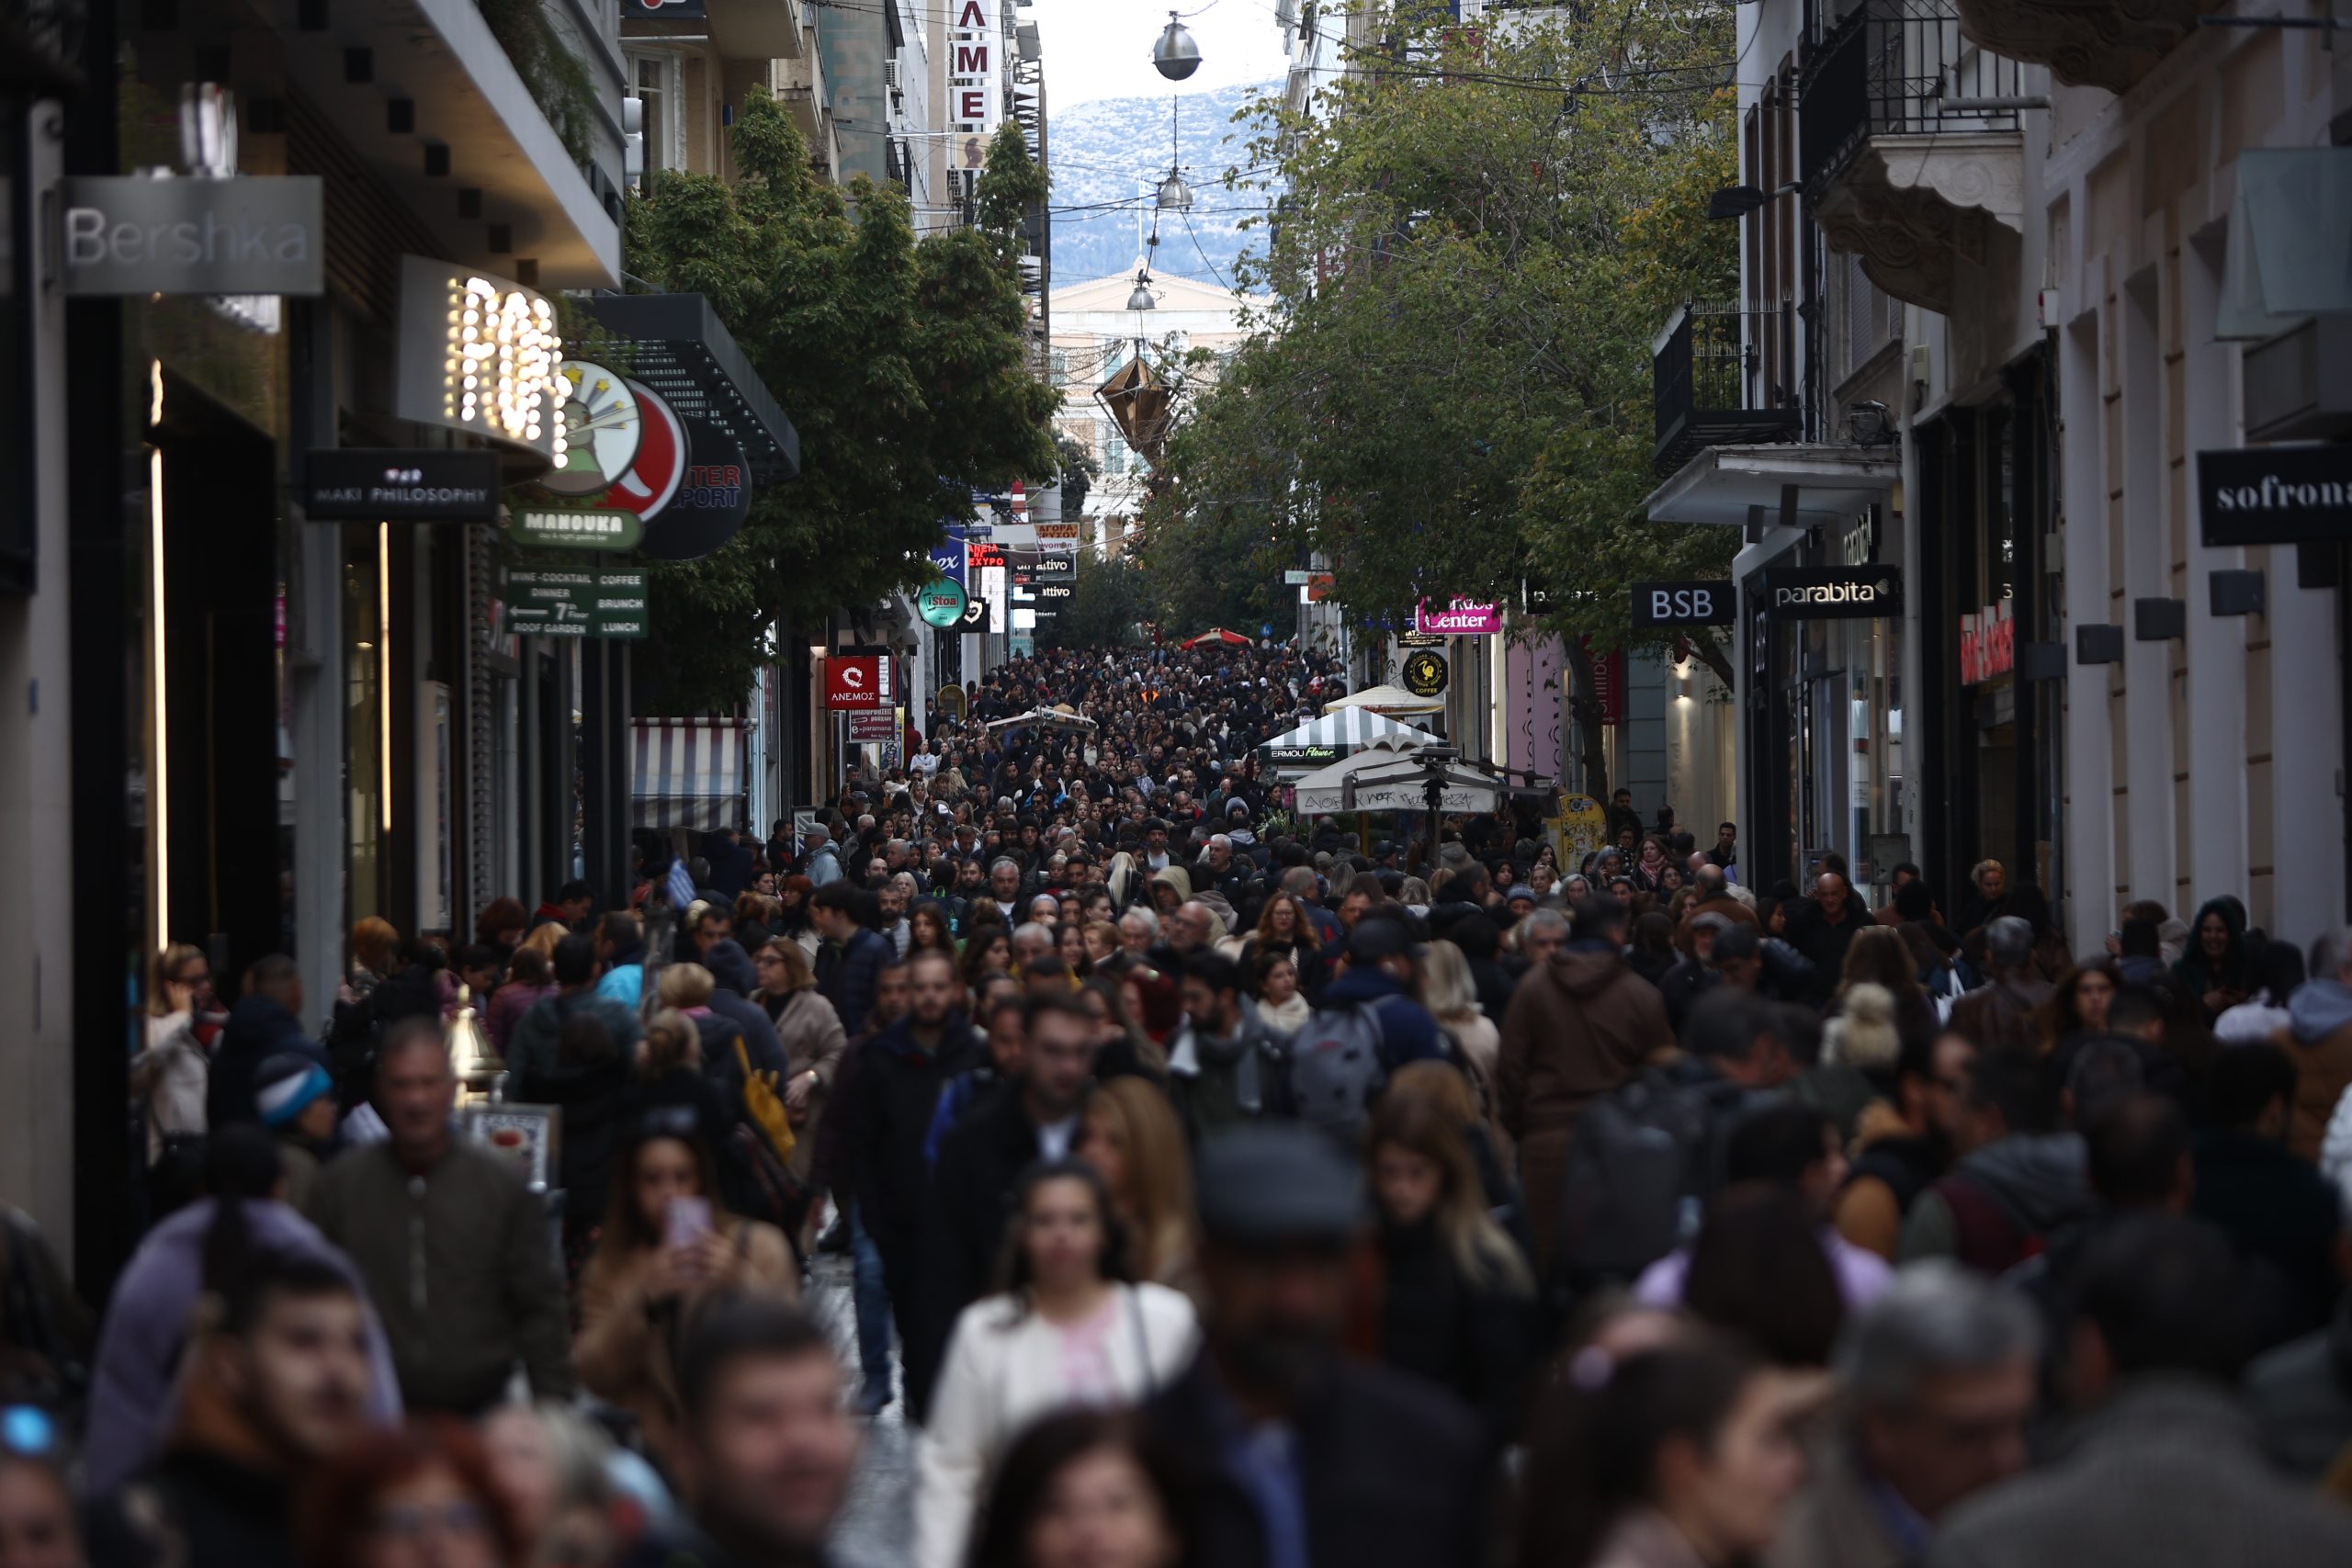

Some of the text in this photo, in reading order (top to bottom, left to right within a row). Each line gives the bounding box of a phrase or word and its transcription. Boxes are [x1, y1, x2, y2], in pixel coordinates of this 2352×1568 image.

[65, 207, 308, 266] Bershka
[684, 465, 741, 487] TER
[314, 487, 488, 503] MAKI PHILOSOPHY
[525, 512, 623, 533] MANOUKA
[968, 544, 999, 553] ΑΝΕΙΑ
[968, 558, 1004, 567] ΕΧΥΡΟ
[599, 575, 642, 585] COFFEE
[530, 588, 571, 598] DINNER
[1775, 580, 1875, 607] parabita
[597, 599, 644, 609] BRUNCH
[1651, 589, 1714, 619] BSB
[514, 622, 586, 634] ROOF GARDEN
[602, 622, 639, 632] LUNCH
[831, 692, 876, 702] ΑΝΕΜΟΣ
[1305, 746, 1335, 758] Flower
